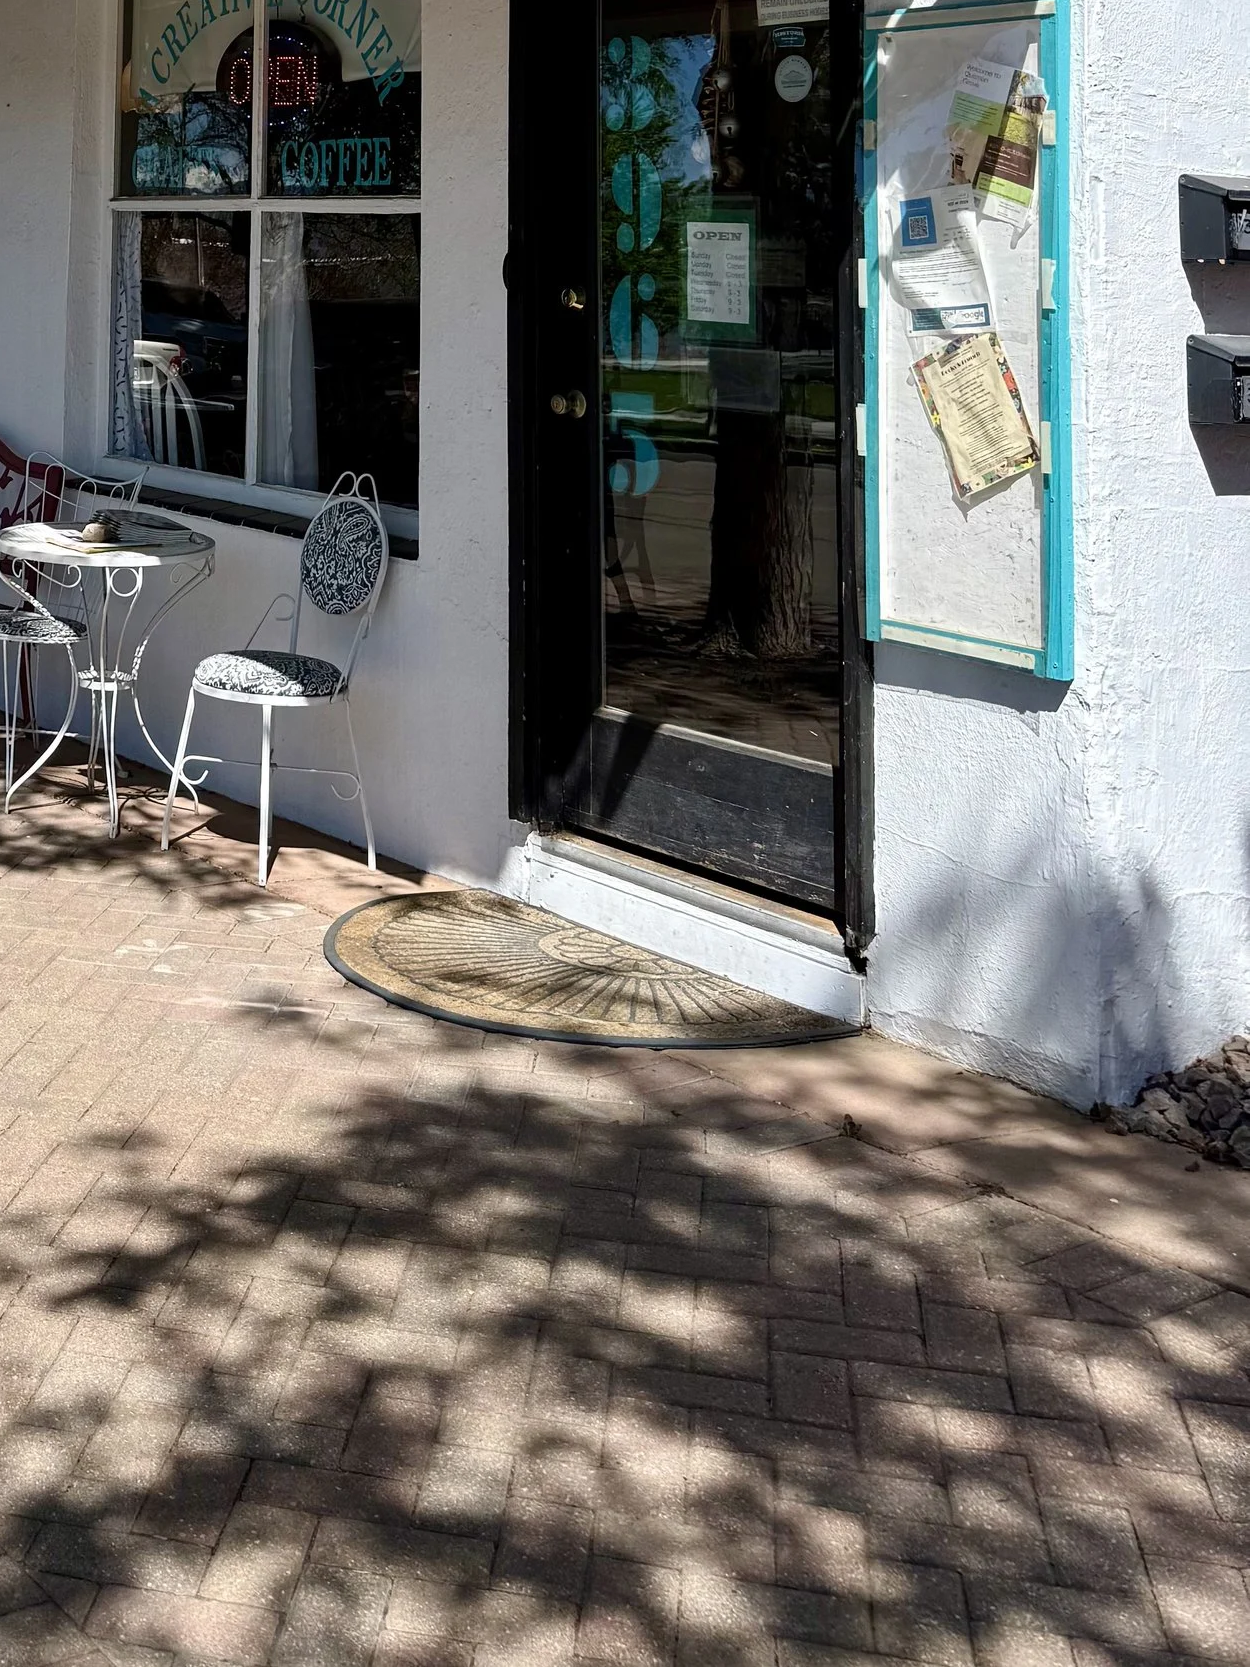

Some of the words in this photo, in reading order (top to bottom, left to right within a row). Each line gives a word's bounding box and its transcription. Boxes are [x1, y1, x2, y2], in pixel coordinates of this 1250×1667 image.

[230, 55, 318, 106] OEN
[281, 137, 392, 187] COFFEE
[693, 231, 742, 242] OPEN
